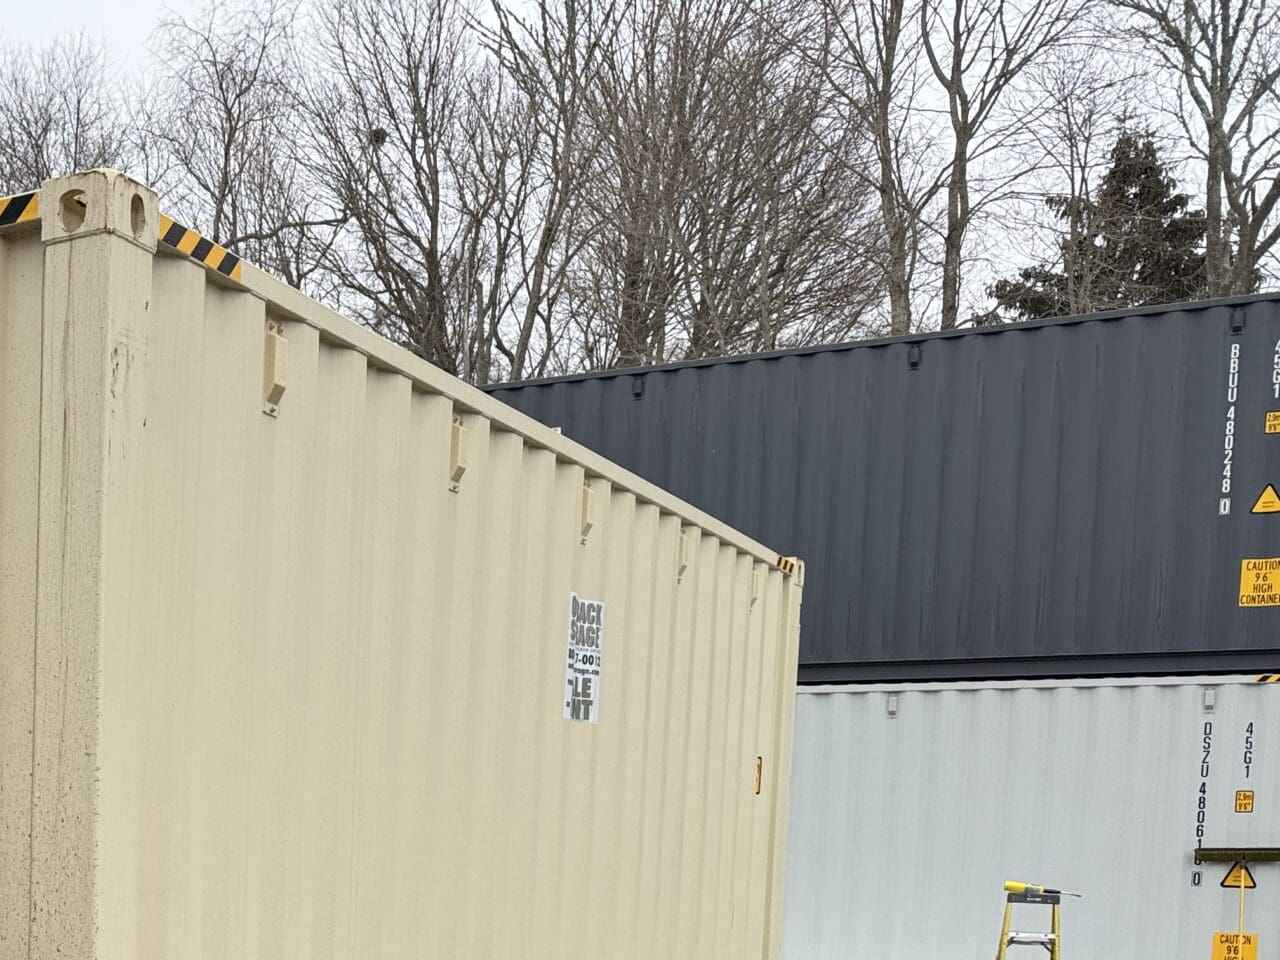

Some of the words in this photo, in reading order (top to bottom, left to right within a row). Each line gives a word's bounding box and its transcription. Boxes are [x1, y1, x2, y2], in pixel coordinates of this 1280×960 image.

[1227, 343, 1240, 403] BBUU
[1221, 405, 1236, 493] 480248
[1240, 594, 1280, 605] CONTAINE
[1252, 583, 1273, 593] HIGH
[1201, 722, 1212, 778] DSZU
[1244, 722, 1254, 778] 45G1
[1193, 872, 1201, 886] 0
[1219, 934, 1252, 945] CAUTON
